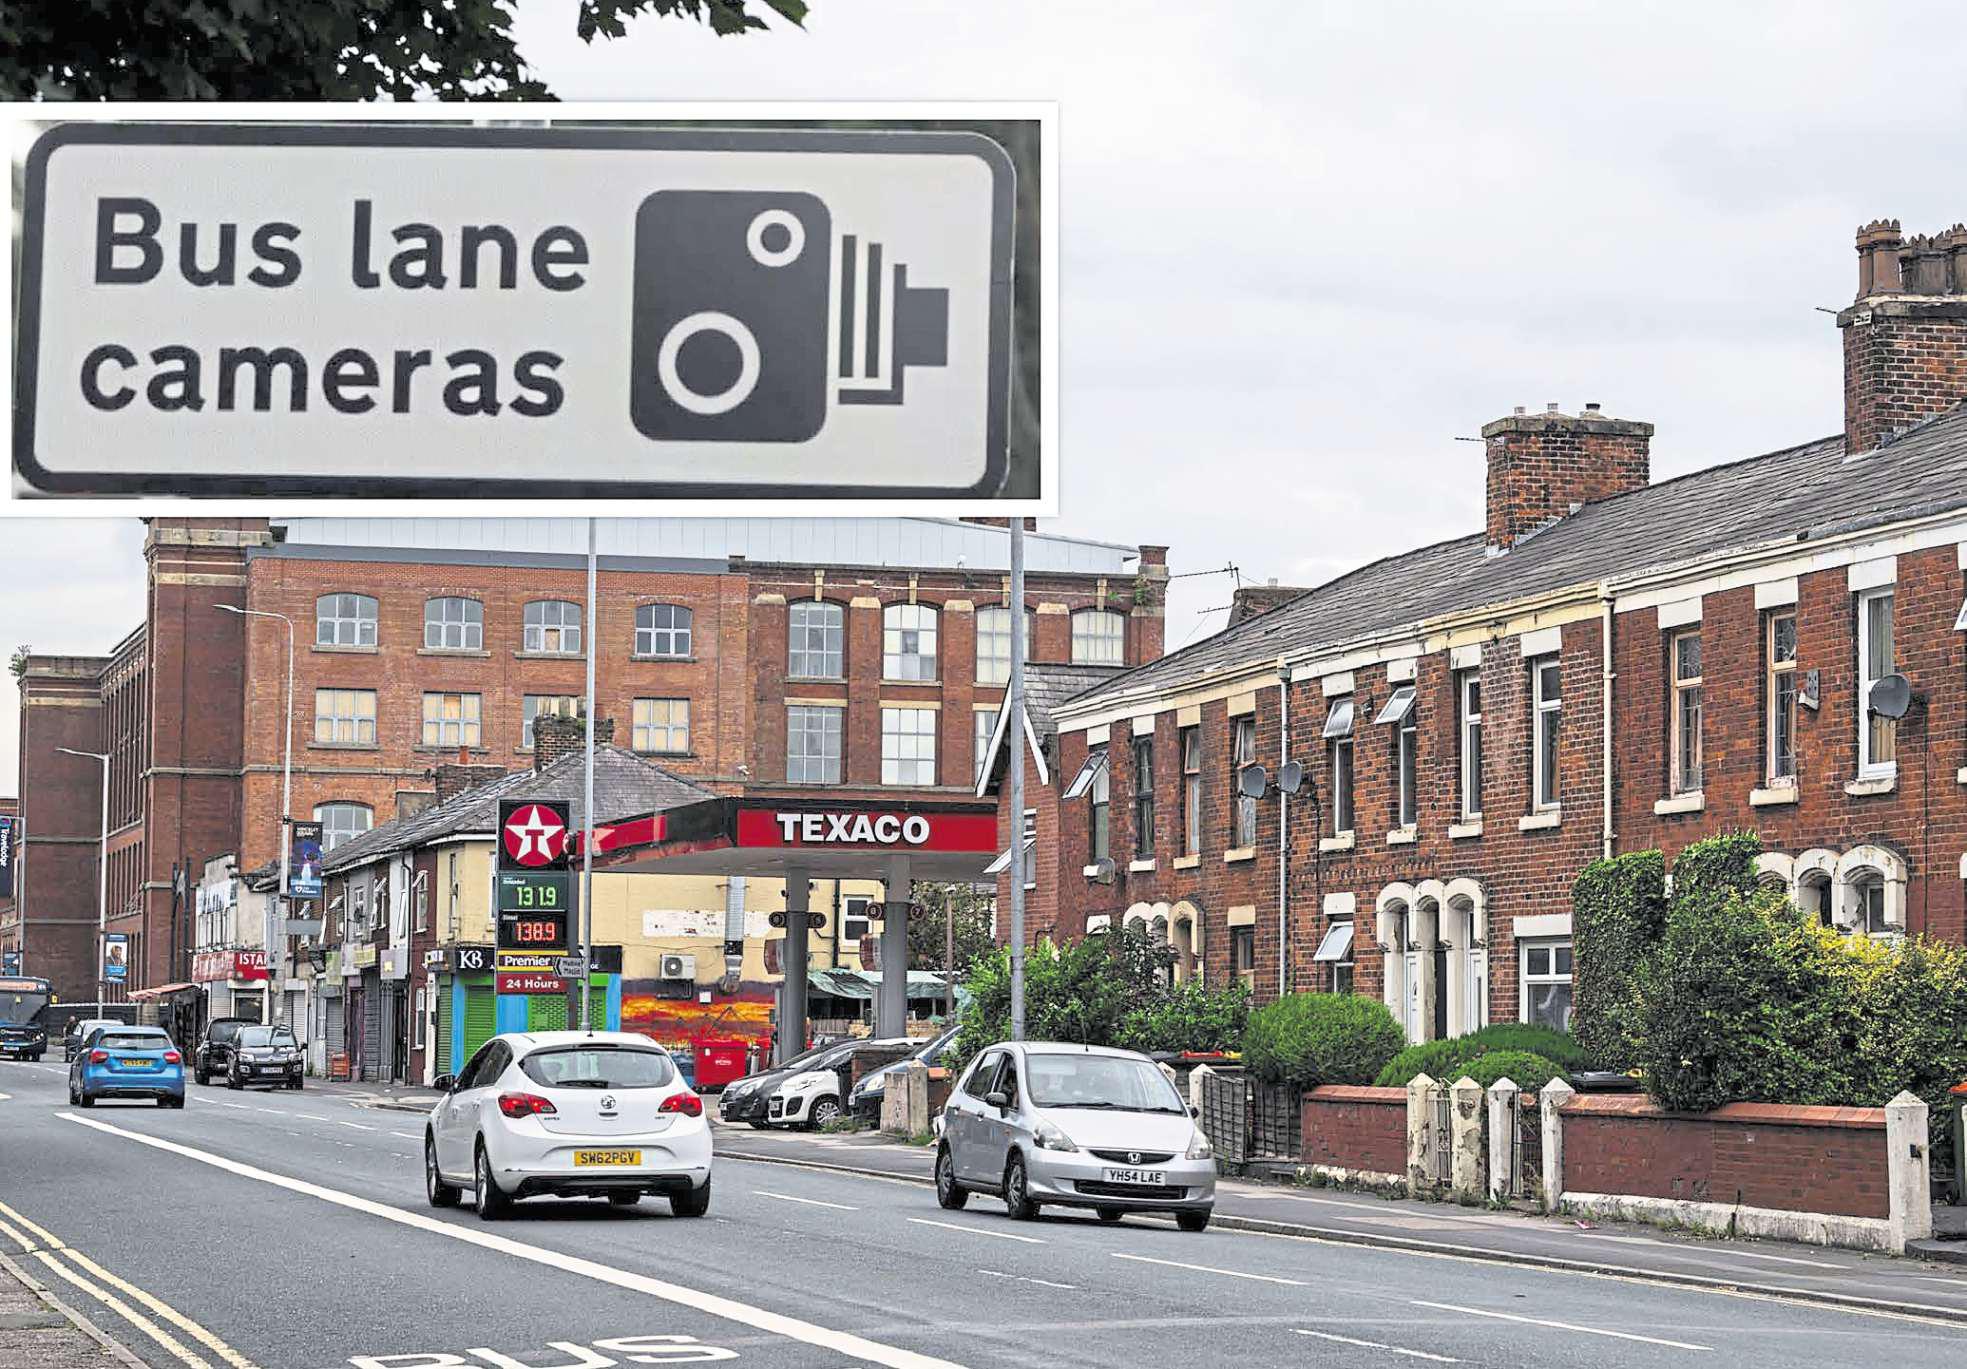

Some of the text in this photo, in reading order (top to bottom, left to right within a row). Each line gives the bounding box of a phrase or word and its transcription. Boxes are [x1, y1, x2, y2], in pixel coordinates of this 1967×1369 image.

[95, 197, 590, 291] Bus lane
[80, 344, 566, 418] cameras
[776, 813, 930, 844] TEXACO
[516, 922, 555, 941] 138.9
[504, 956, 551, 967] Premier
[506, 978, 560, 989] 24 Hours
[580, 1153, 635, 1164] SW62PGV
[1109, 1169, 1162, 1183] YH54 LAE
